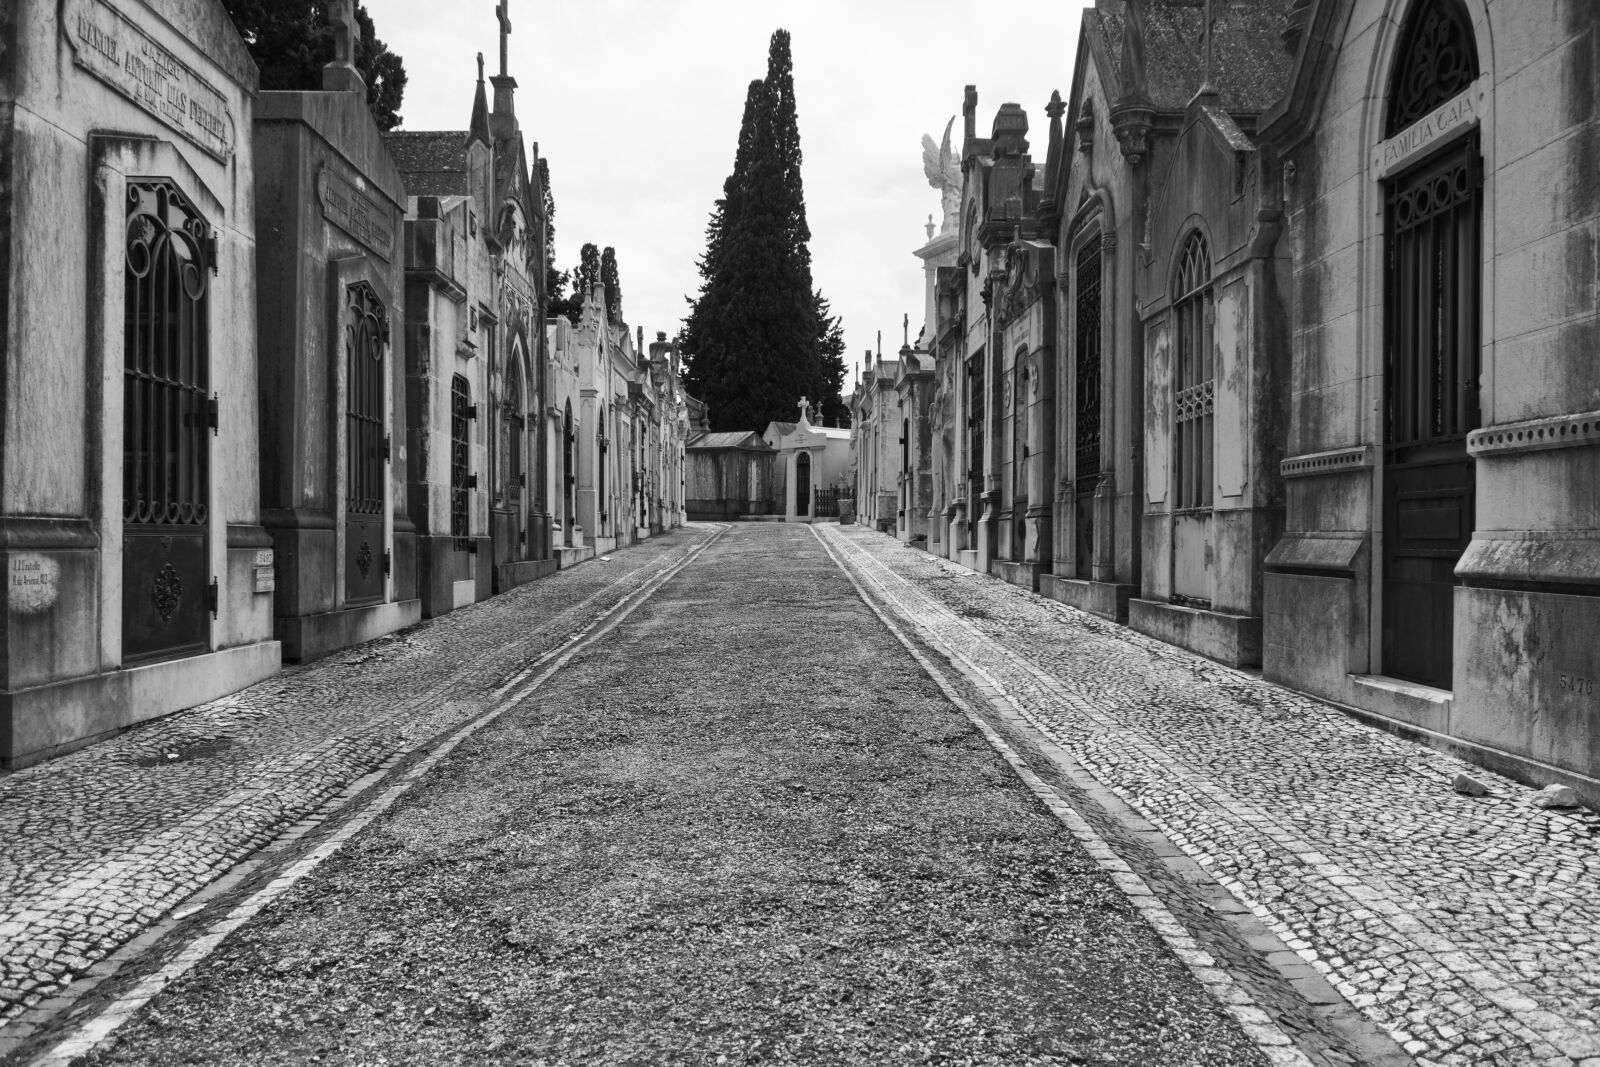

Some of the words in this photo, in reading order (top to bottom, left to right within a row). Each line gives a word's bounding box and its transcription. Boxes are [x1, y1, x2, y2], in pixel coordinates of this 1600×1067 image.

[141, 39, 180, 80] JAZIGO
[1384, 122, 1433, 165] FAMILIA
[1559, 674, 1593, 696] 5476
